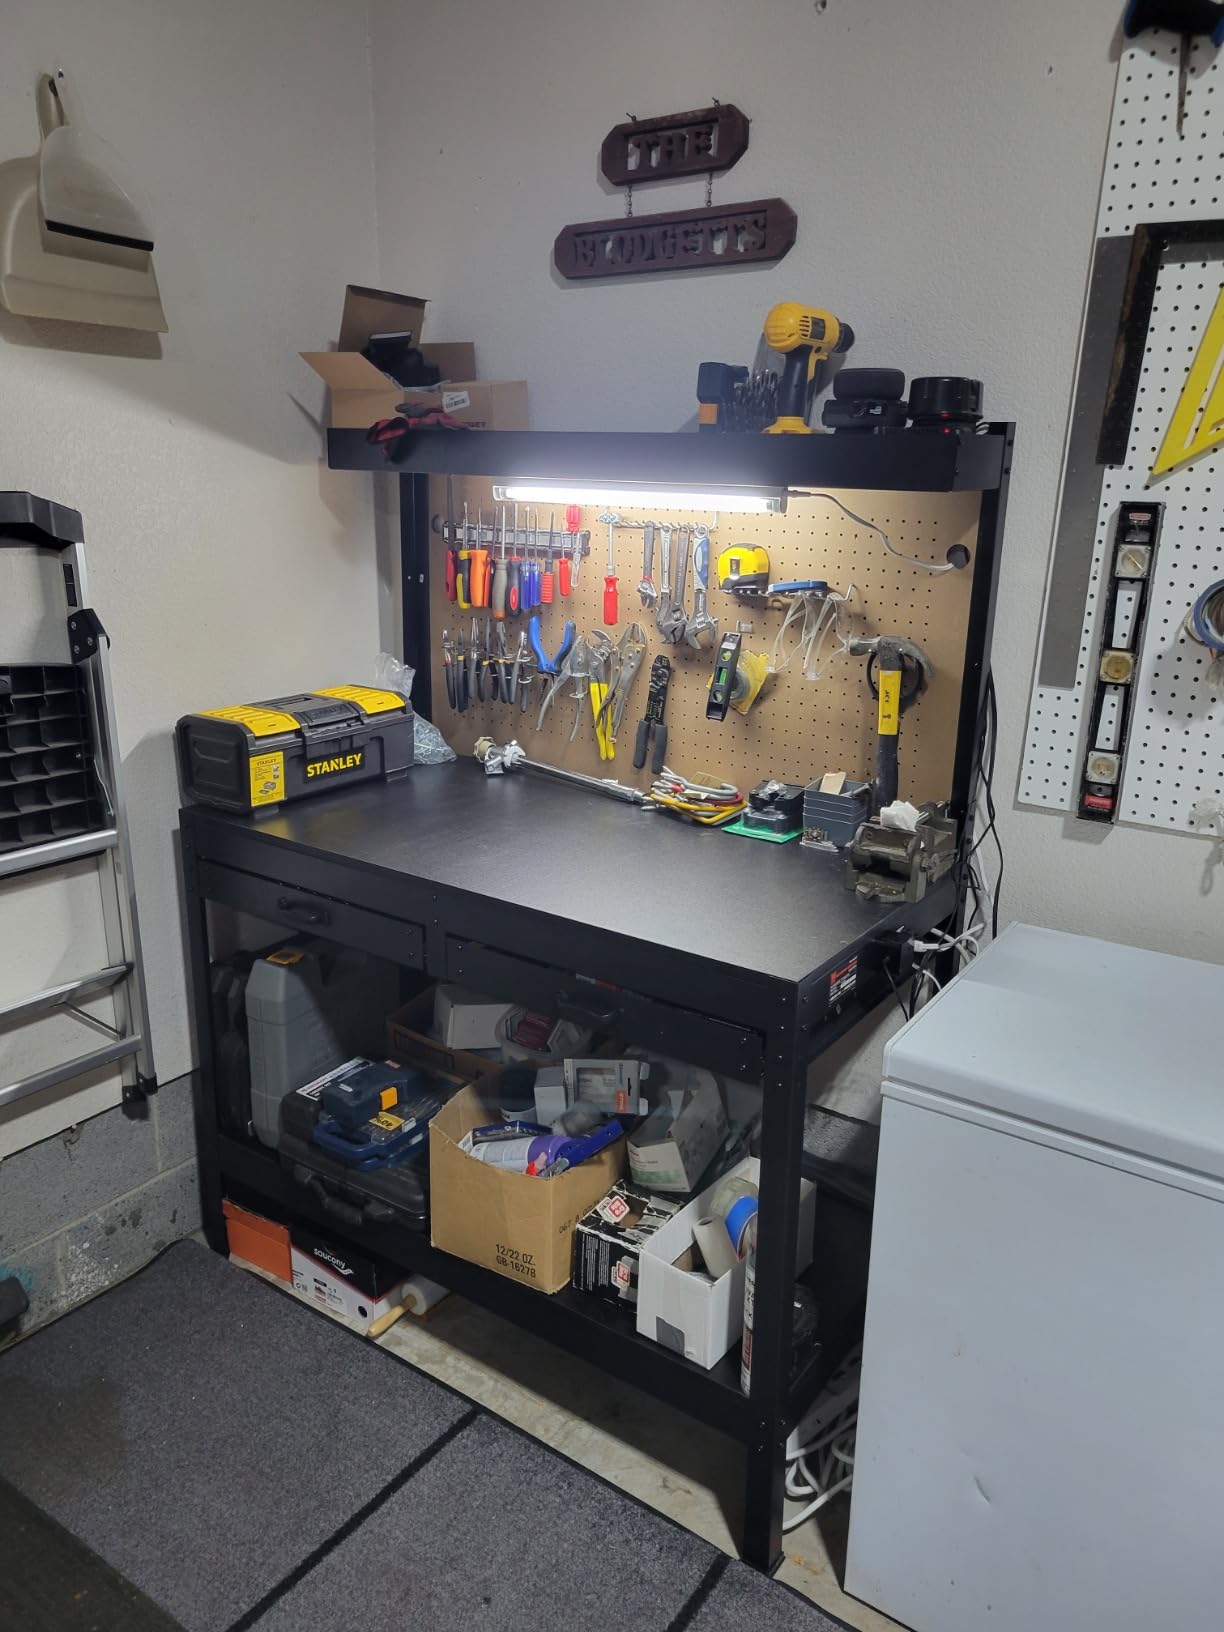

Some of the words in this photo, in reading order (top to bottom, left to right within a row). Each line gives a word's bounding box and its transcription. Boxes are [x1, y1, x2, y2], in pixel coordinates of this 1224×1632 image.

[627, 126, 715, 170] THE
[306, 753, 362, 778] STANLEY
[313, 1247, 346, 1270] saucony
[495, 1244, 520, 1261] 12/22
[496, 1255, 537, 1278] GB-16278
